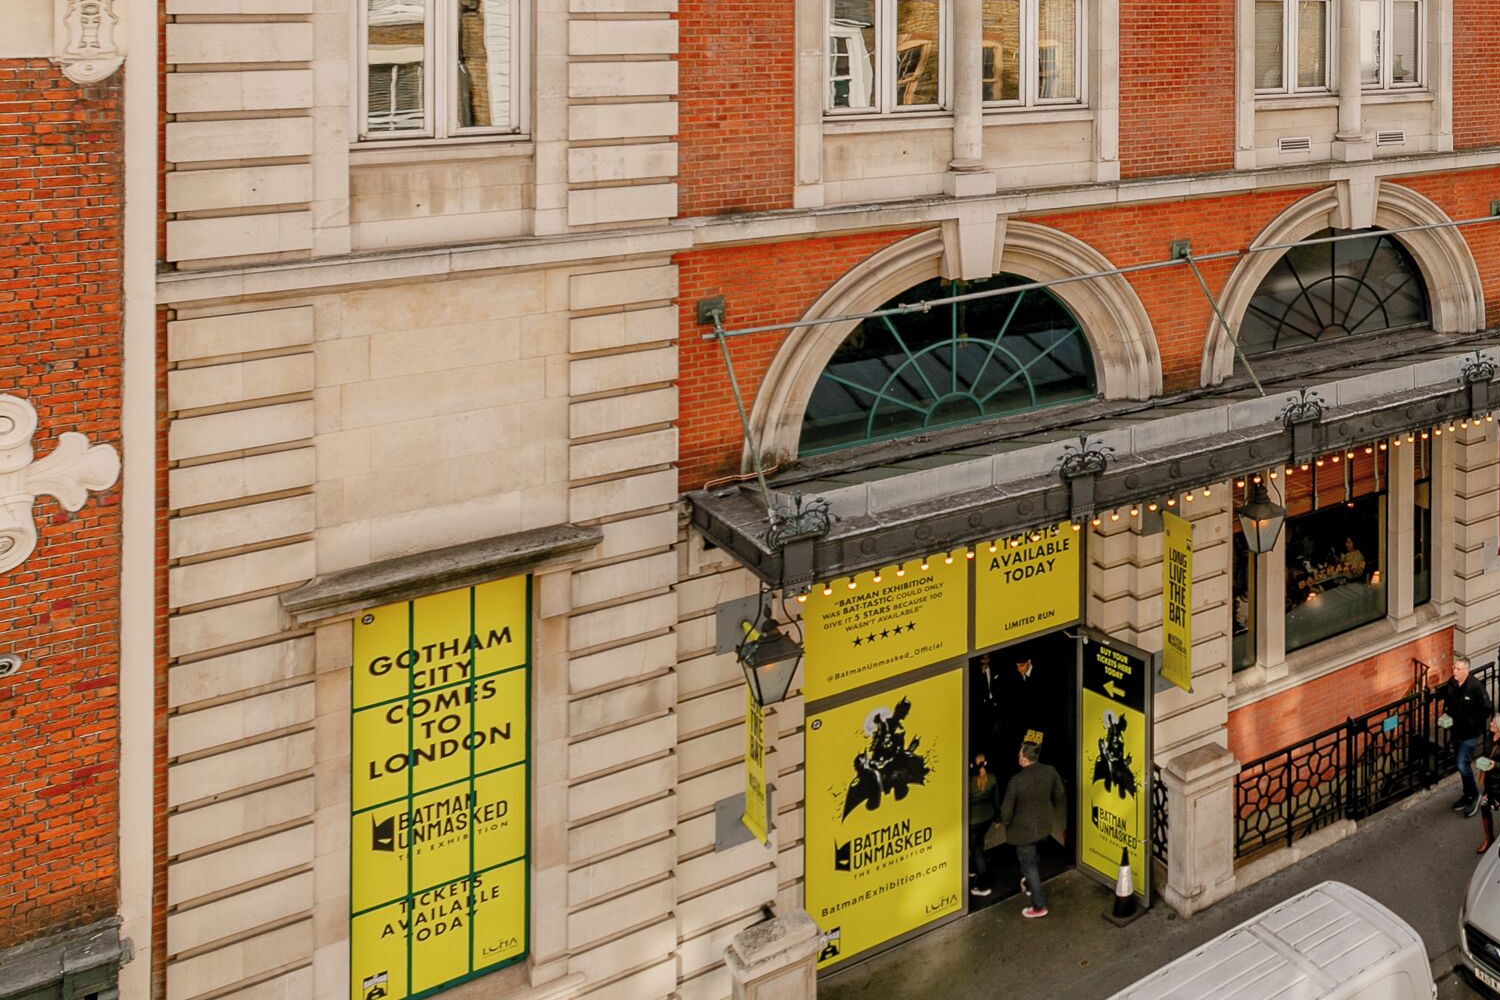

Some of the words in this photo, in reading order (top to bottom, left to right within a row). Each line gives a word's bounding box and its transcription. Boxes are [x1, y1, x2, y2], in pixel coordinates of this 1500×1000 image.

[990, 538, 1070, 571] AVAILABLE
[1004, 558, 1056, 584] TODAY
[1169, 547, 1187, 568] LONG
[882, 576, 934, 595] EXHIBITION
[1169, 562, 1187, 587] LIVE
[822, 610, 841, 620] WAS
[896, 588, 923, 600] COULD
[924, 582, 944, 593] ONLY
[1168, 580, 1186, 607] THE
[823, 620, 842, 630] GIVE
[845, 617, 852, 625] IT
[854, 613, 860, 621] 5
[863, 603, 891, 618] STARS
[893, 596, 928, 610] BECAUSE
[929, 592, 943, 601] 100
[1004, 616, 1035, 631] LIMITED
[1037, 610, 1055, 621] RUN
[1168, 602, 1187, 629] BAT
[369, 626, 512, 676] GOTHAM
[827, 642, 943, 682] @BatmanUnmasked_Official
[1096, 653, 1117, 669] TICKETS
[1117, 663, 1132, 675] HERE
[1100, 646, 1112, 657] BUY
[1112, 651, 1128, 664] YOUR
[412, 658, 472, 691] CITY
[1104, 666, 1123, 680] TODAY
[386, 680, 497, 725] COMES
[421, 714, 462, 739] TO
[369, 722, 512, 780] LONDON
[399, 790, 478, 831] BATMAN
[399, 800, 508, 850] UNMASKED
[1099, 807, 1126, 831] BATMAN
[398, 849, 422, 861] TE
[430, 821, 509, 851] EXHIBTION
[853, 818, 911, 853] BATMAN
[853, 826, 933, 869] UNMASKED
[1099, 820, 1137, 850] UNMASKED
[853, 869, 871, 880] THE
[876, 845, 933, 871] EXHIBITION
[399, 874, 483, 914] TICKETS
[821, 861, 947, 917] BatmanExhibition.com
[382, 885, 500, 939] AVAILABLE
